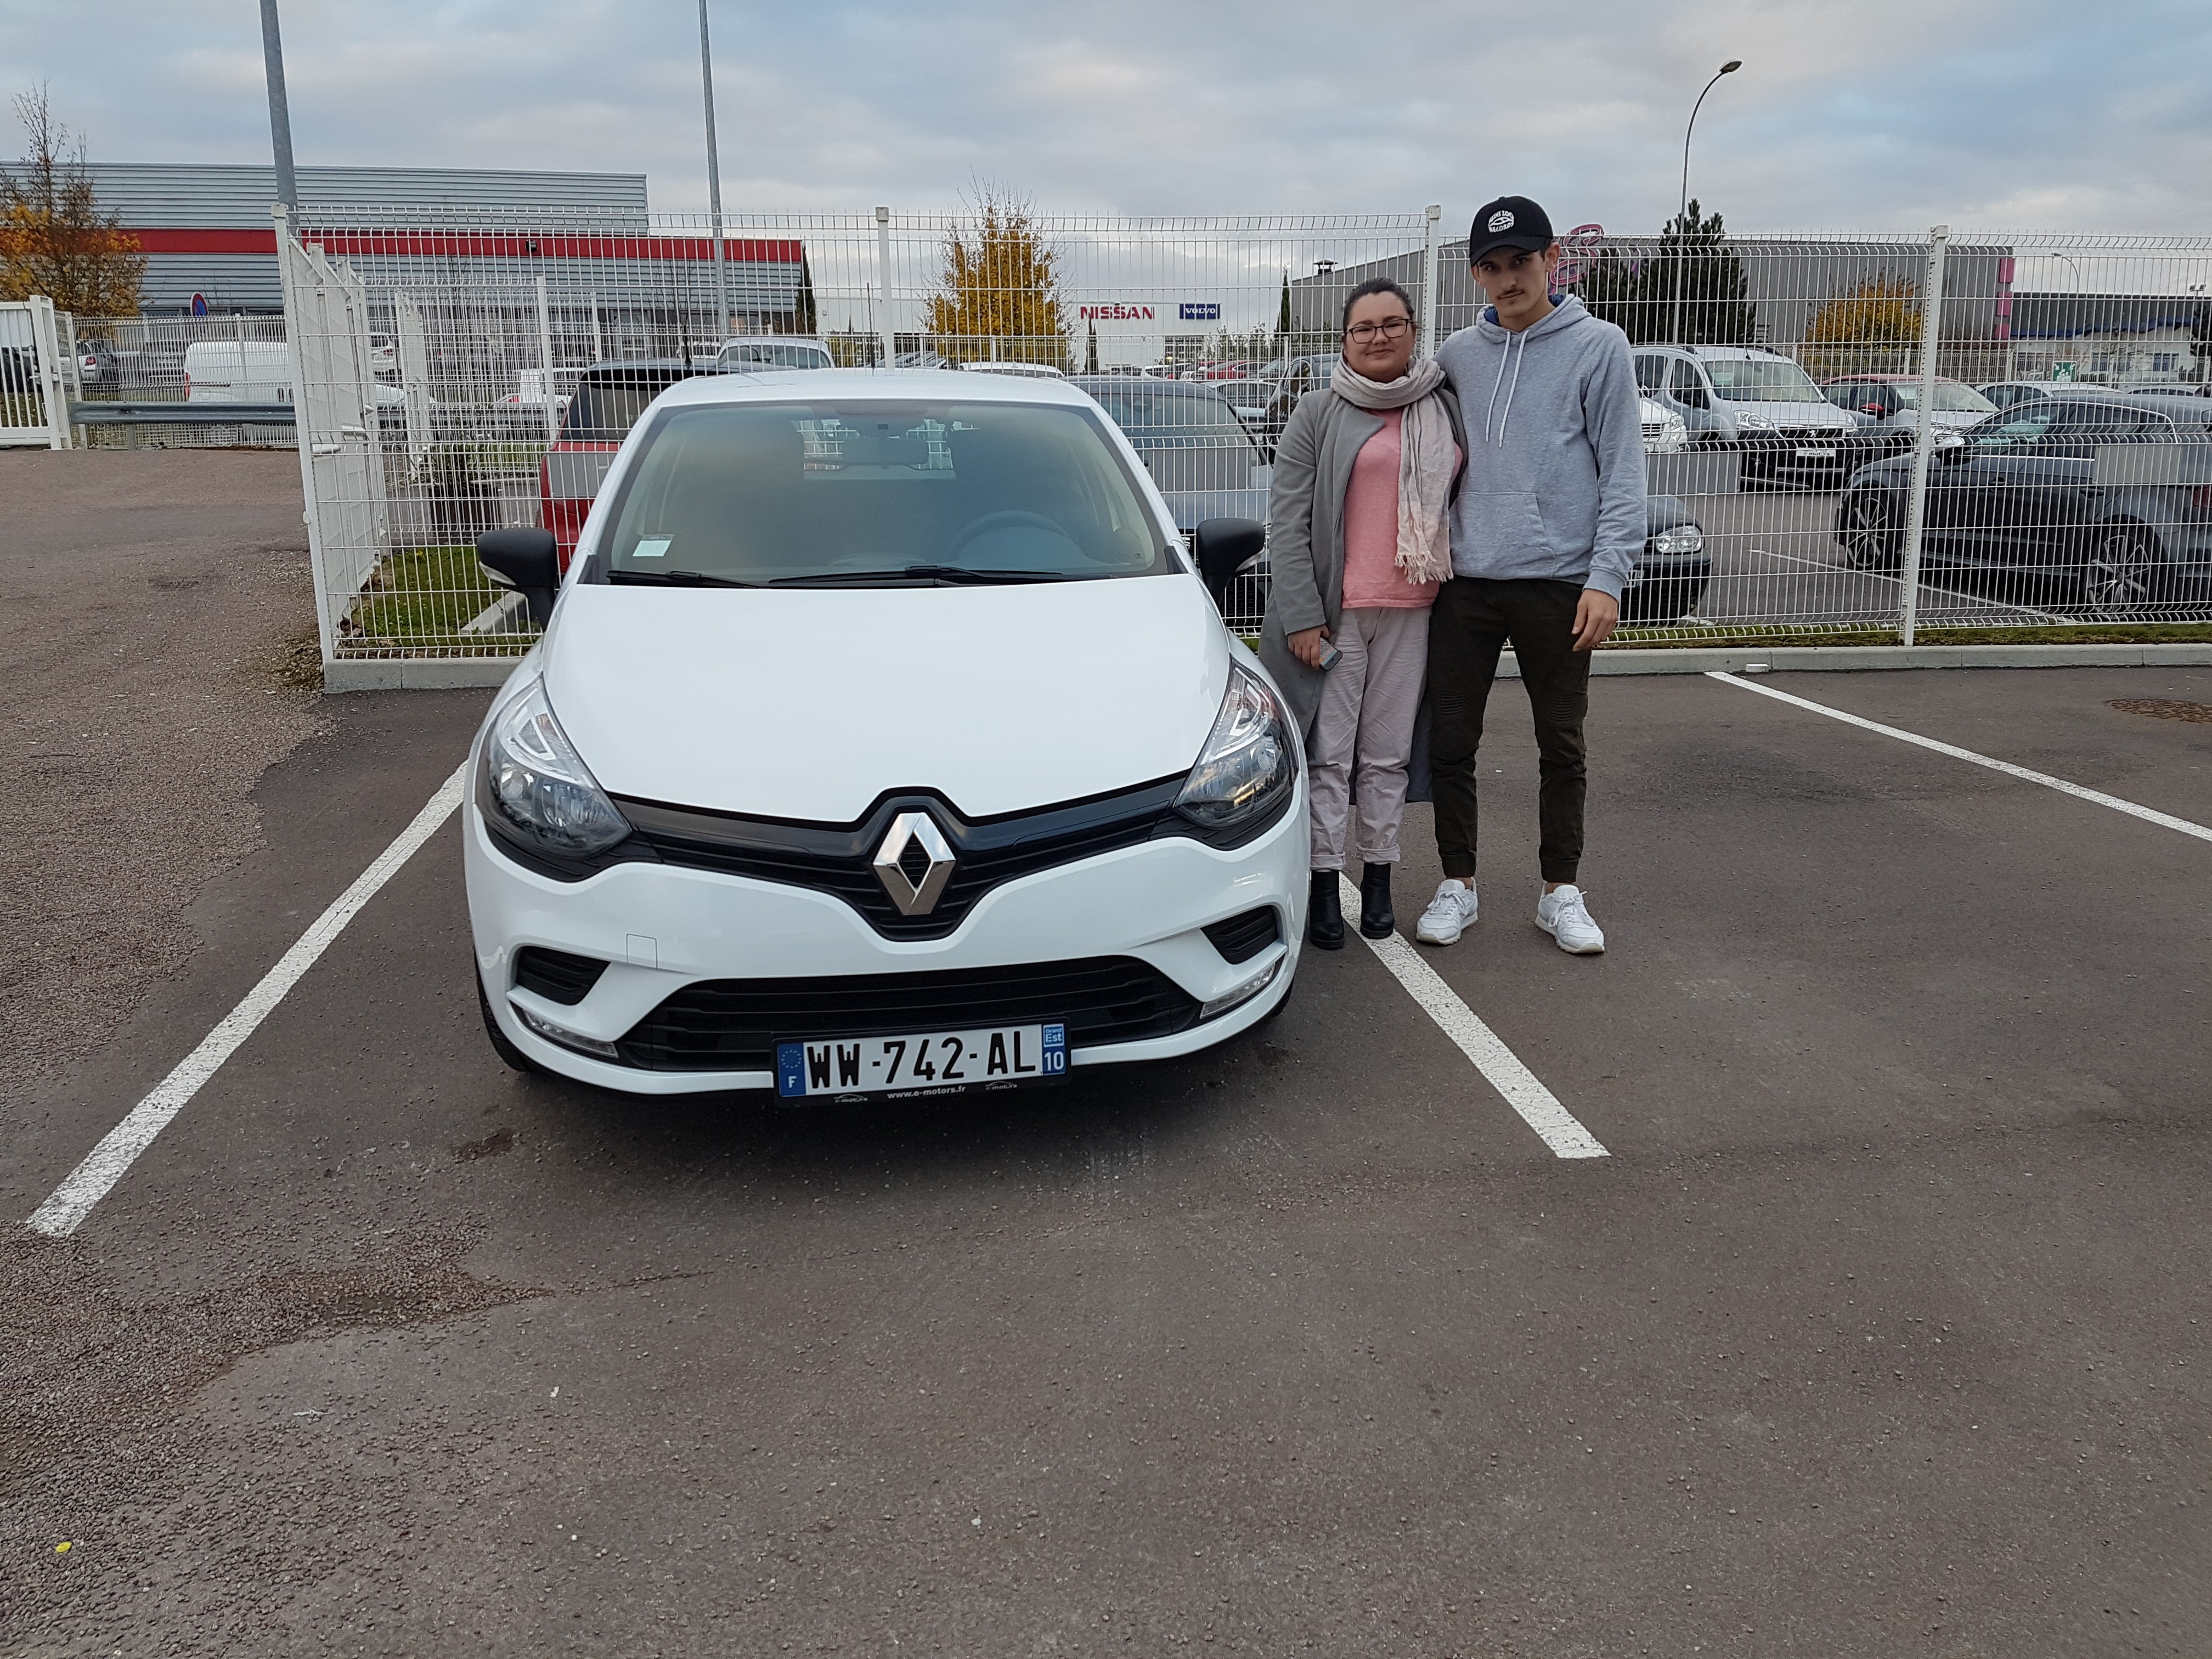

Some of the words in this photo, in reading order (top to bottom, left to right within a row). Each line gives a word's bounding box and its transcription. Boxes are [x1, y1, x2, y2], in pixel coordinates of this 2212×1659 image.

[1502, 210, 1514, 220] ZOO
[1080, 306, 1155, 319] NISSAN
[1045, 1033, 1062, 1042] Est
[807, 1031, 1036, 1089] WW-742-AL
[1045, 1051, 1064, 1071] 10
[788, 1076, 797, 1088] F
[887, 1085, 966, 1099] www.e-motors.fr
